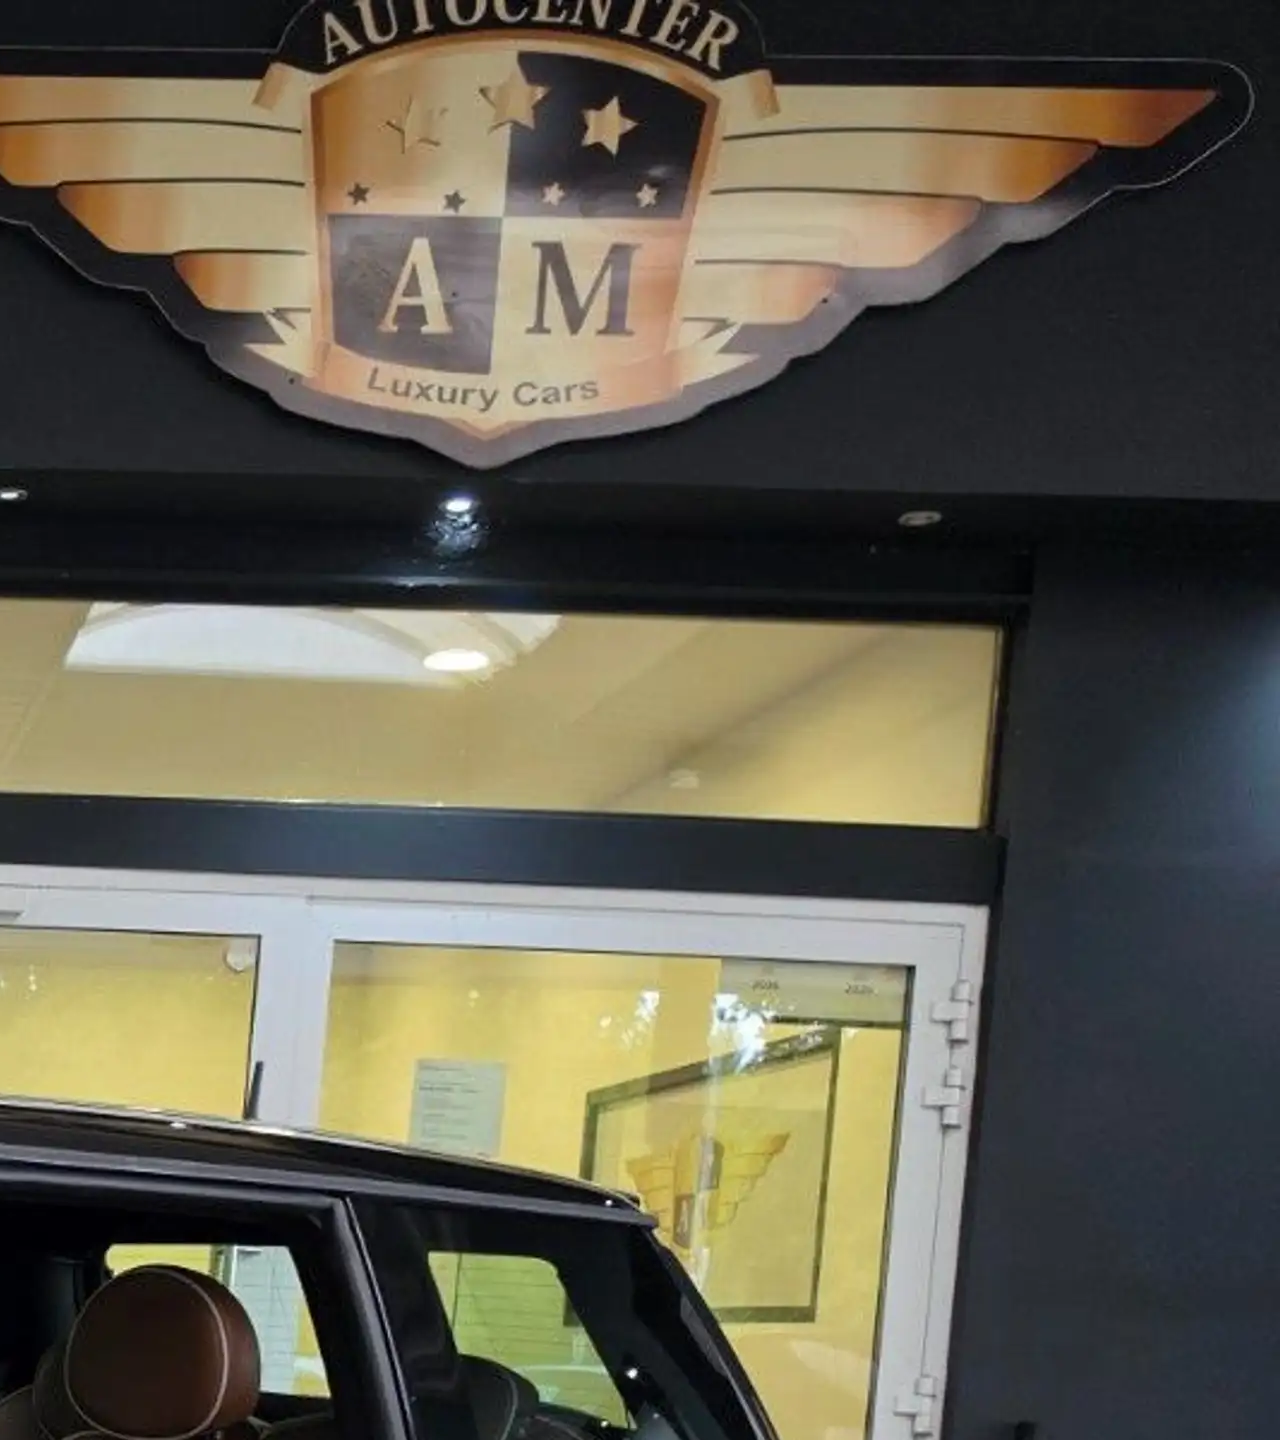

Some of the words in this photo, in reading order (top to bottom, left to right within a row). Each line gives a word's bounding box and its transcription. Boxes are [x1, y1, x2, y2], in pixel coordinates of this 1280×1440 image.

[377, 237, 454, 335] A
[525, 240, 642, 336] M
[367, 366, 500, 412] Luxury
[513, 377, 600, 407] Cars
